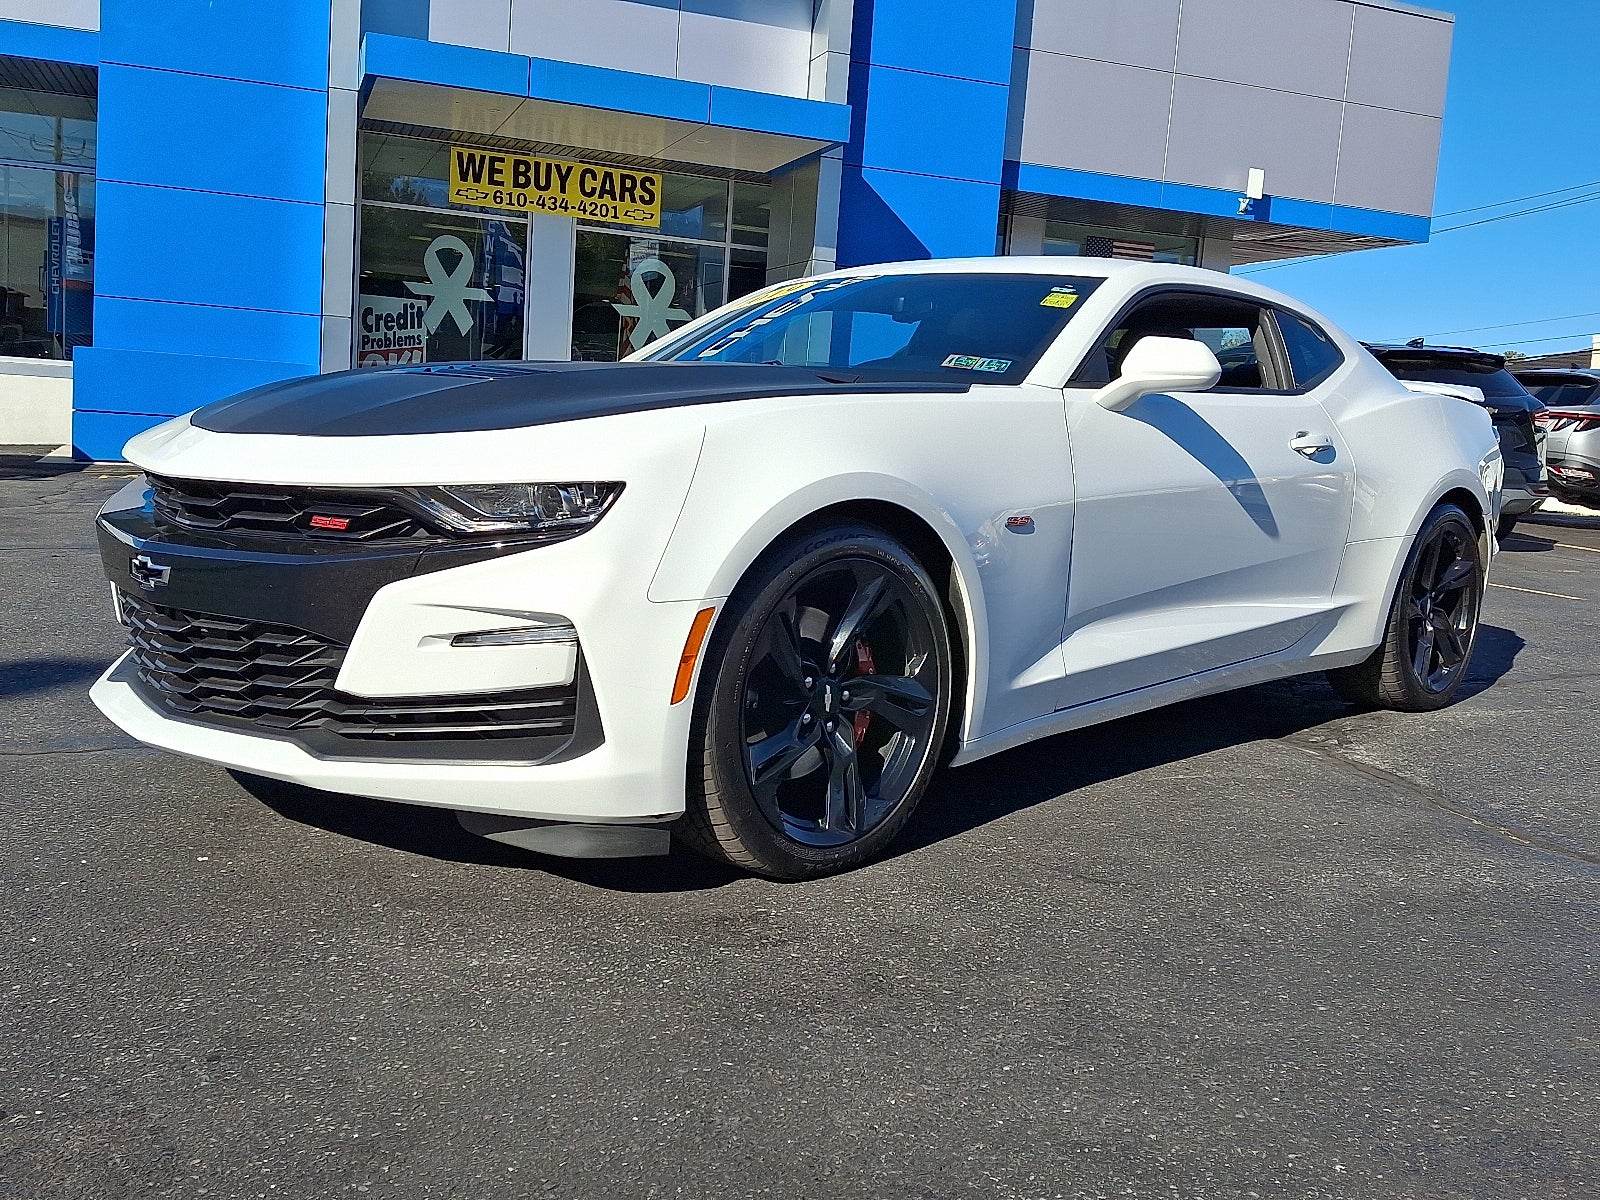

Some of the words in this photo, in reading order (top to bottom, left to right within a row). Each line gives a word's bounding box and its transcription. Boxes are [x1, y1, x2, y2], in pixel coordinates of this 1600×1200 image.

[456, 150, 506, 188] WE
[512, 158, 575, 195] BUY
[579, 167, 656, 207] CARS
[493, 190, 620, 220] 610-434-4201
[51, 217, 60, 295] CHEVROLET
[361, 302, 425, 334] Credit
[361, 330, 423, 351] Problems
